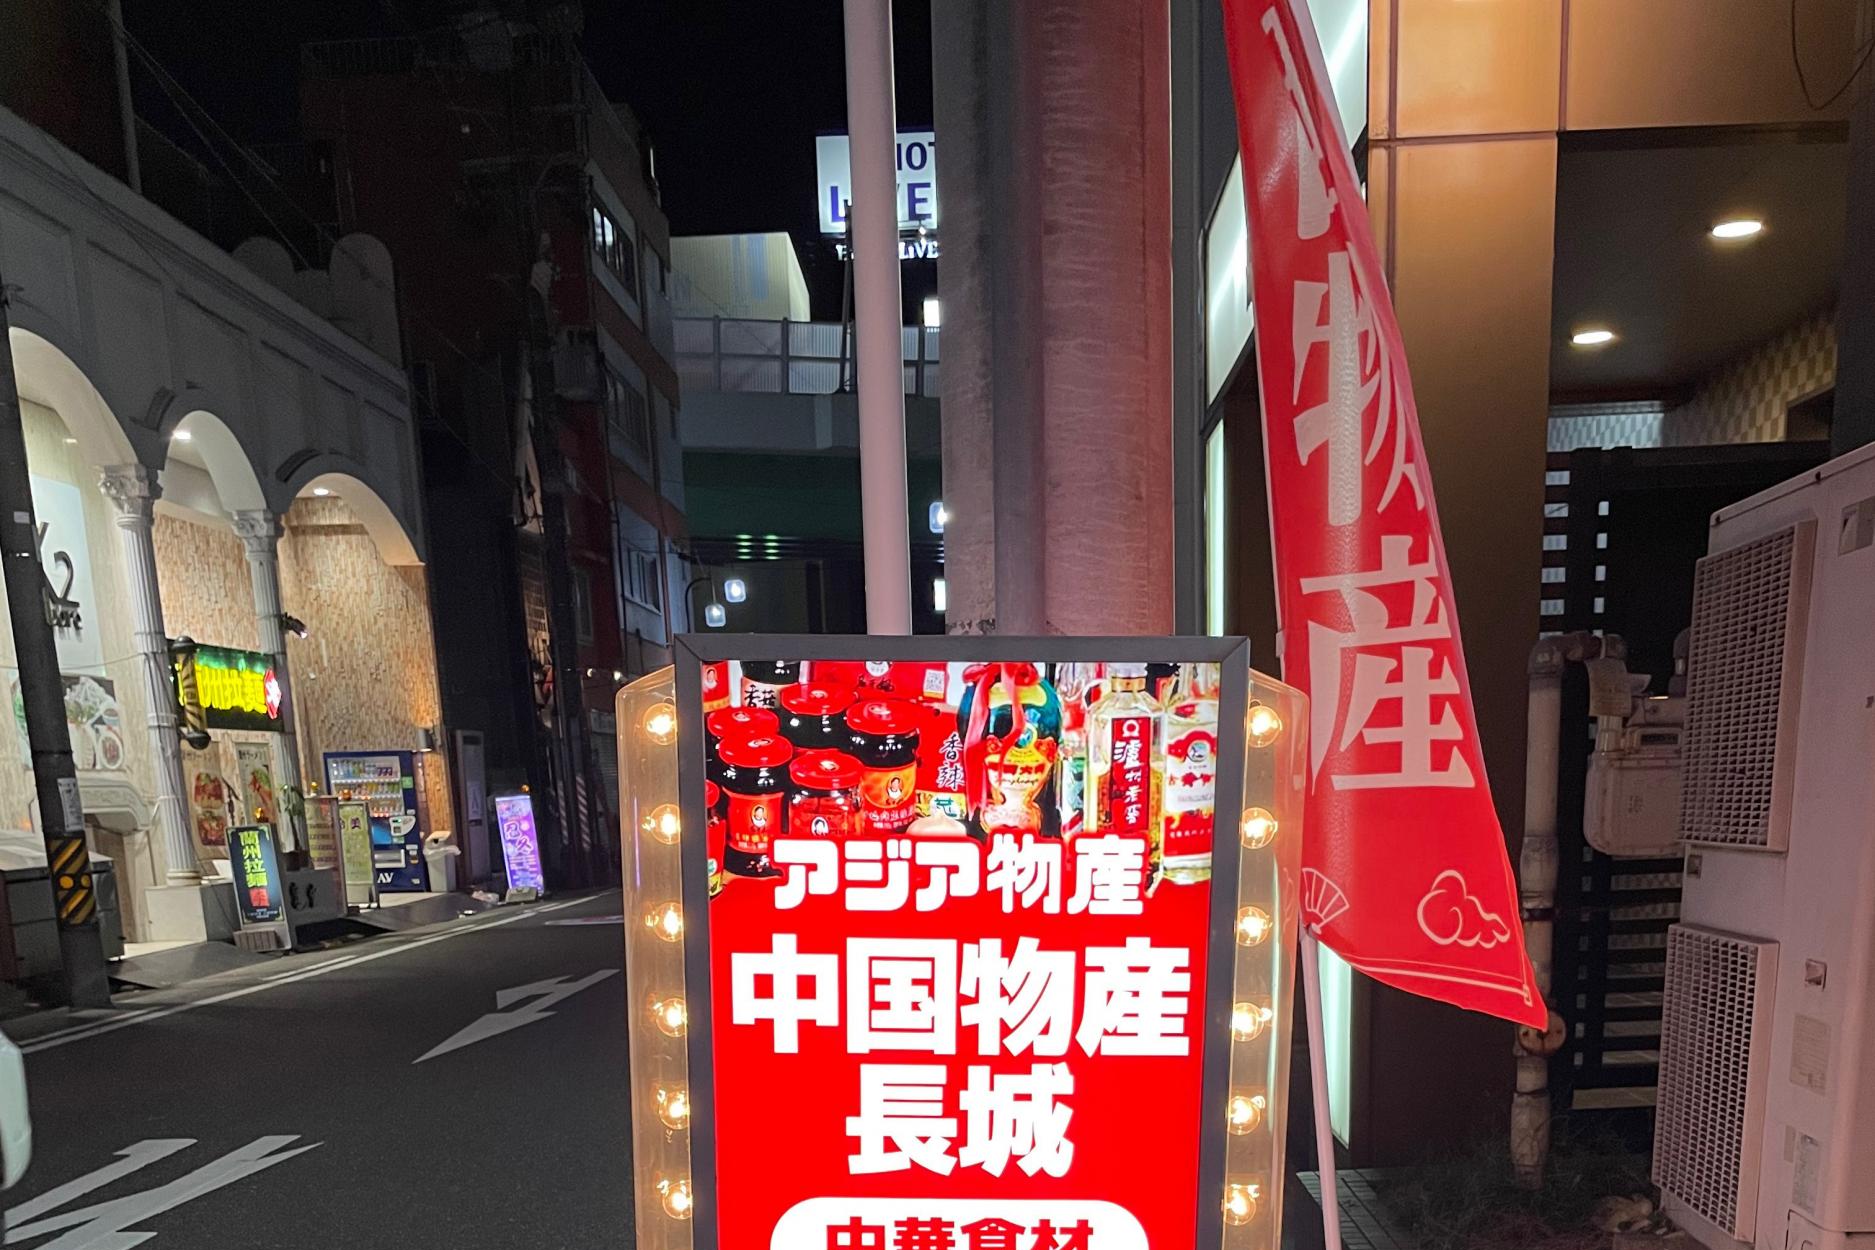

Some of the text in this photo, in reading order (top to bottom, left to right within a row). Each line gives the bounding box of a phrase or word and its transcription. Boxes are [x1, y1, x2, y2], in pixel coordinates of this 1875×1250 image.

[935, 732, 966, 791] 香辣
[774, 834, 1145, 915] アジア物産
[731, 932, 1191, 1057] 中国物産
[845, 1062, 1075, 1177] 長城
